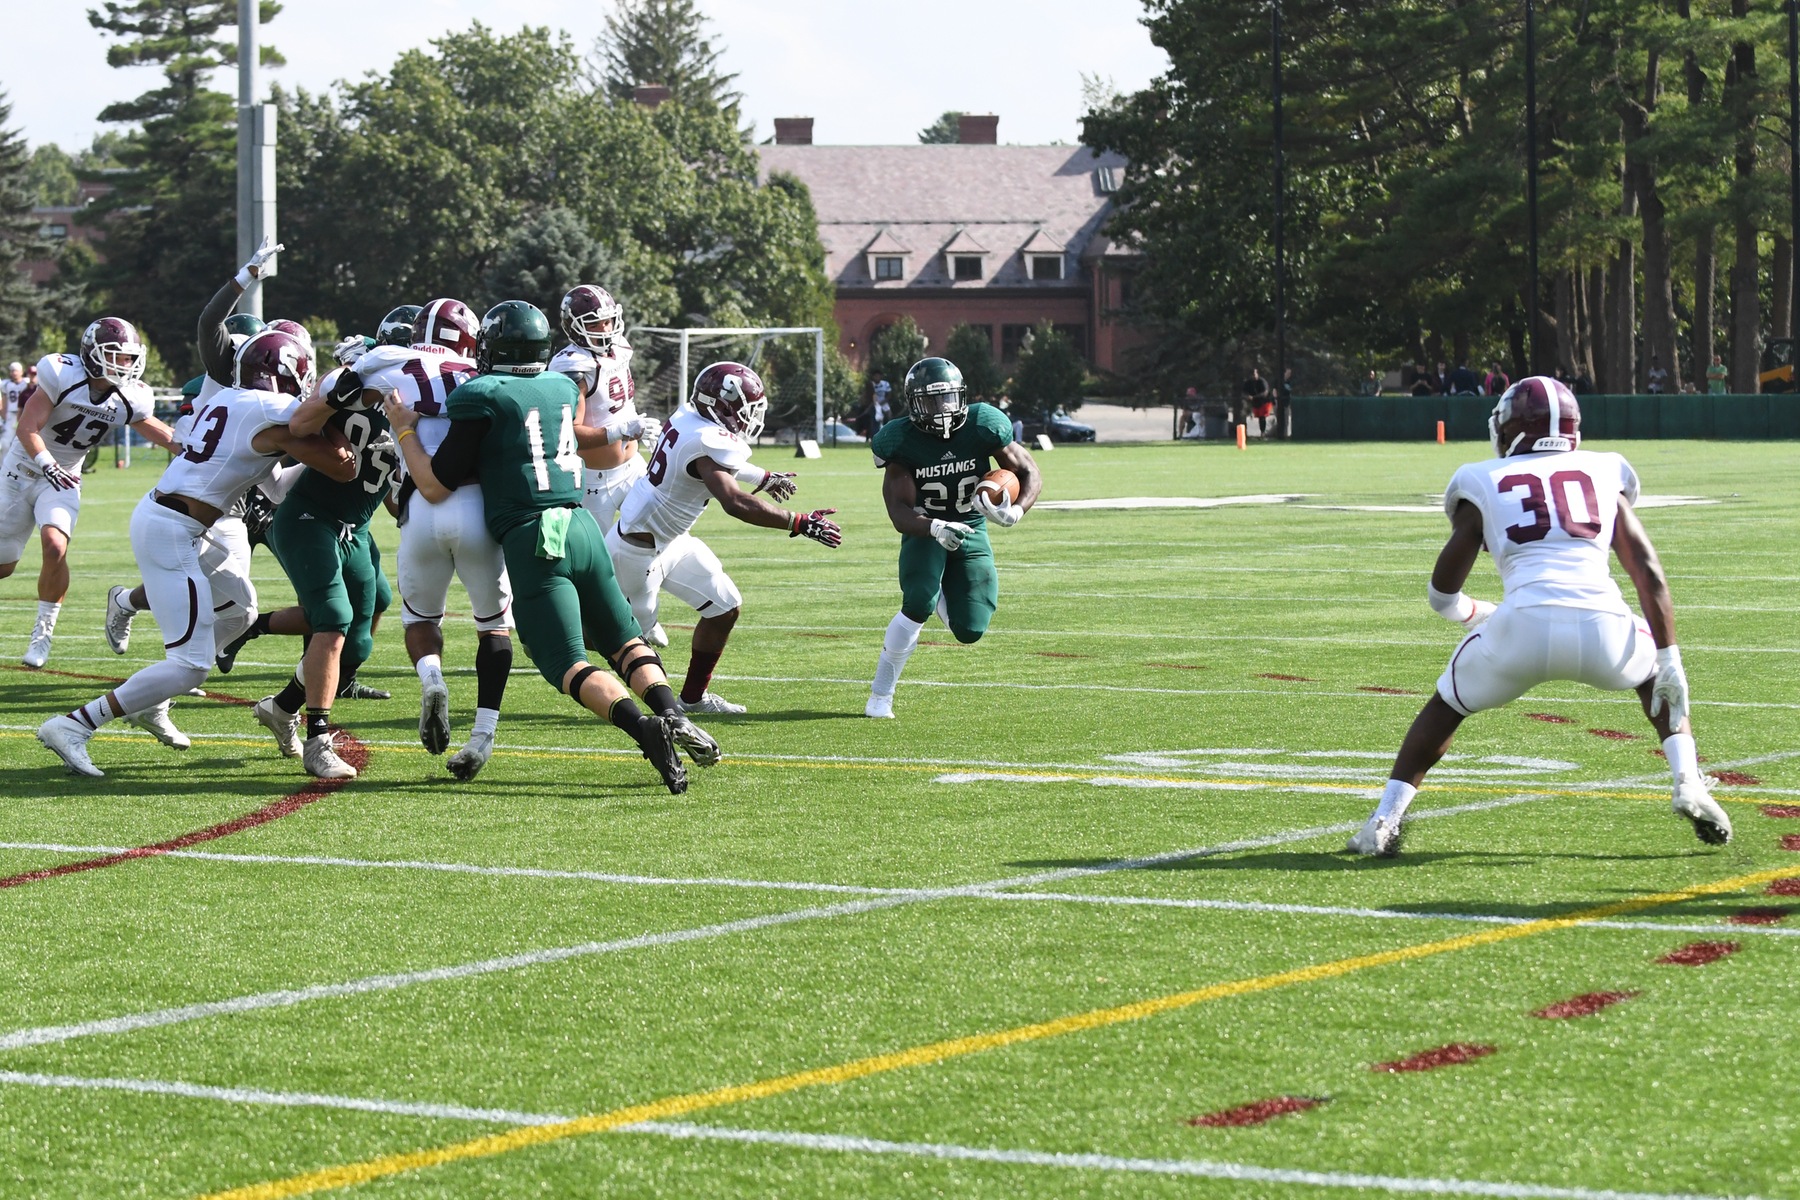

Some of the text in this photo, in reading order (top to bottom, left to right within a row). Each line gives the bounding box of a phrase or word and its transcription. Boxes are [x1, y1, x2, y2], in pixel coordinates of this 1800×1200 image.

[511, 366, 541, 374] Riddell
[69, 403, 116, 423] SPRINGFIELD
[52, 413, 109, 450] 43
[524, 403, 583, 491] 14
[915, 458, 977, 479] MUSTANGS
[1497, 469, 1602, 545] 30
